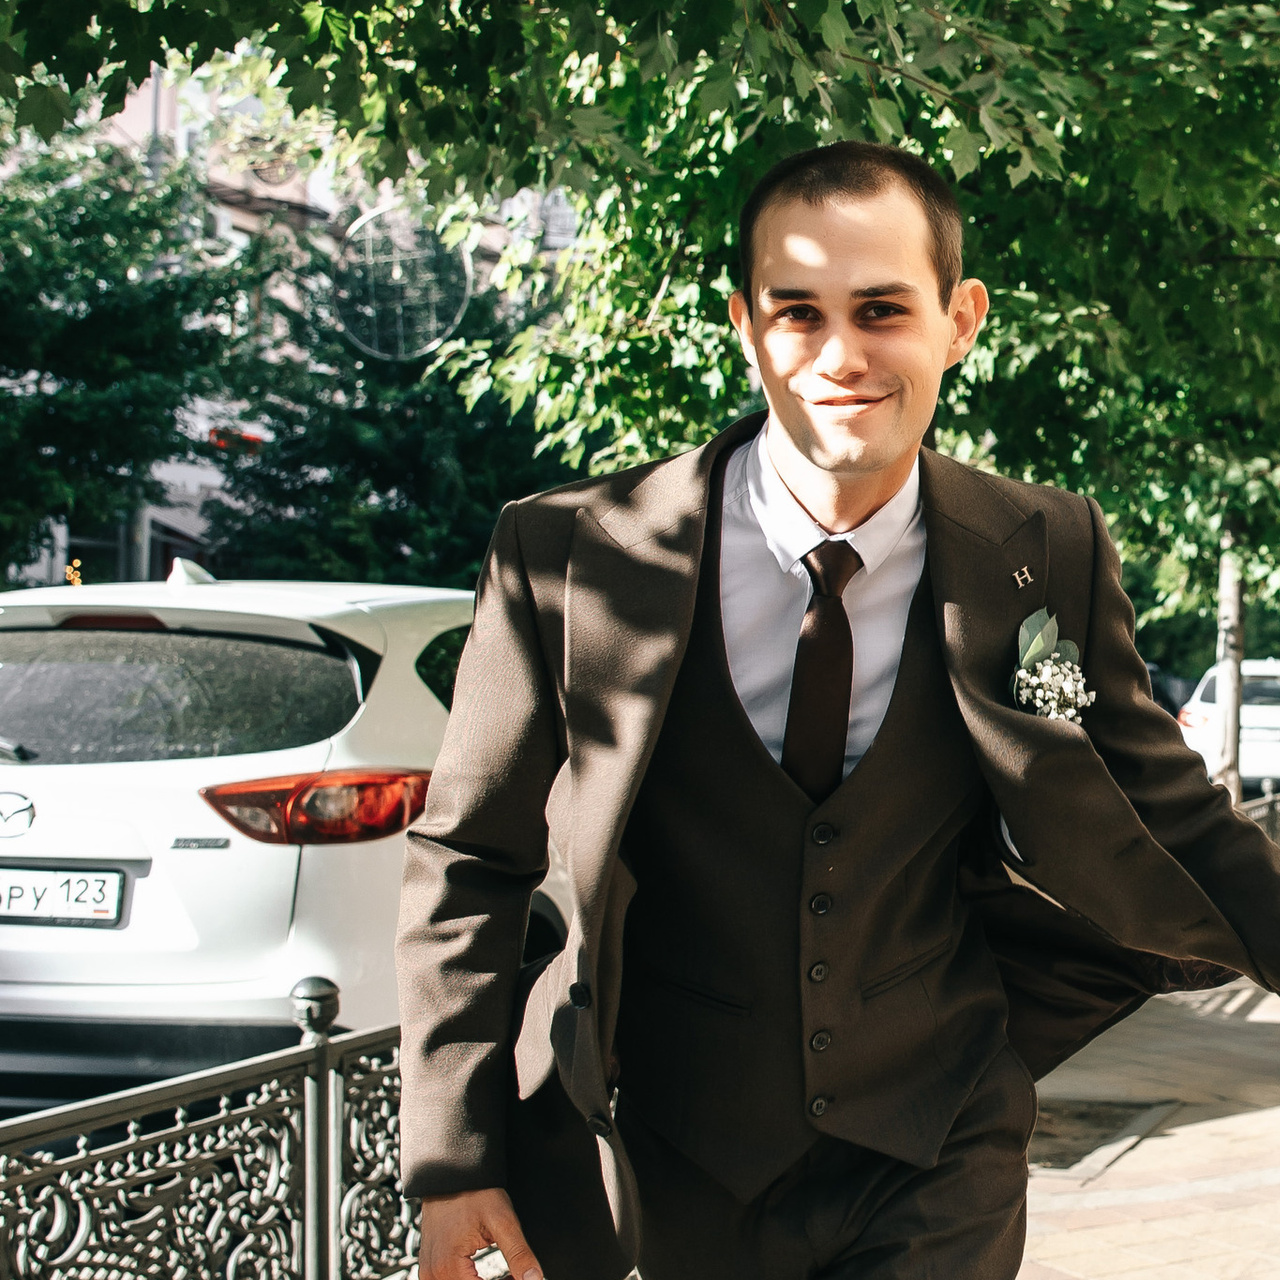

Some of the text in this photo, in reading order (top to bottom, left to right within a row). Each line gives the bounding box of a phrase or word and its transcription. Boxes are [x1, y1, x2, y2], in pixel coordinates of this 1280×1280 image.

[1012, 565, 1034, 589] H
[0, 878, 107, 911] РУ 123
